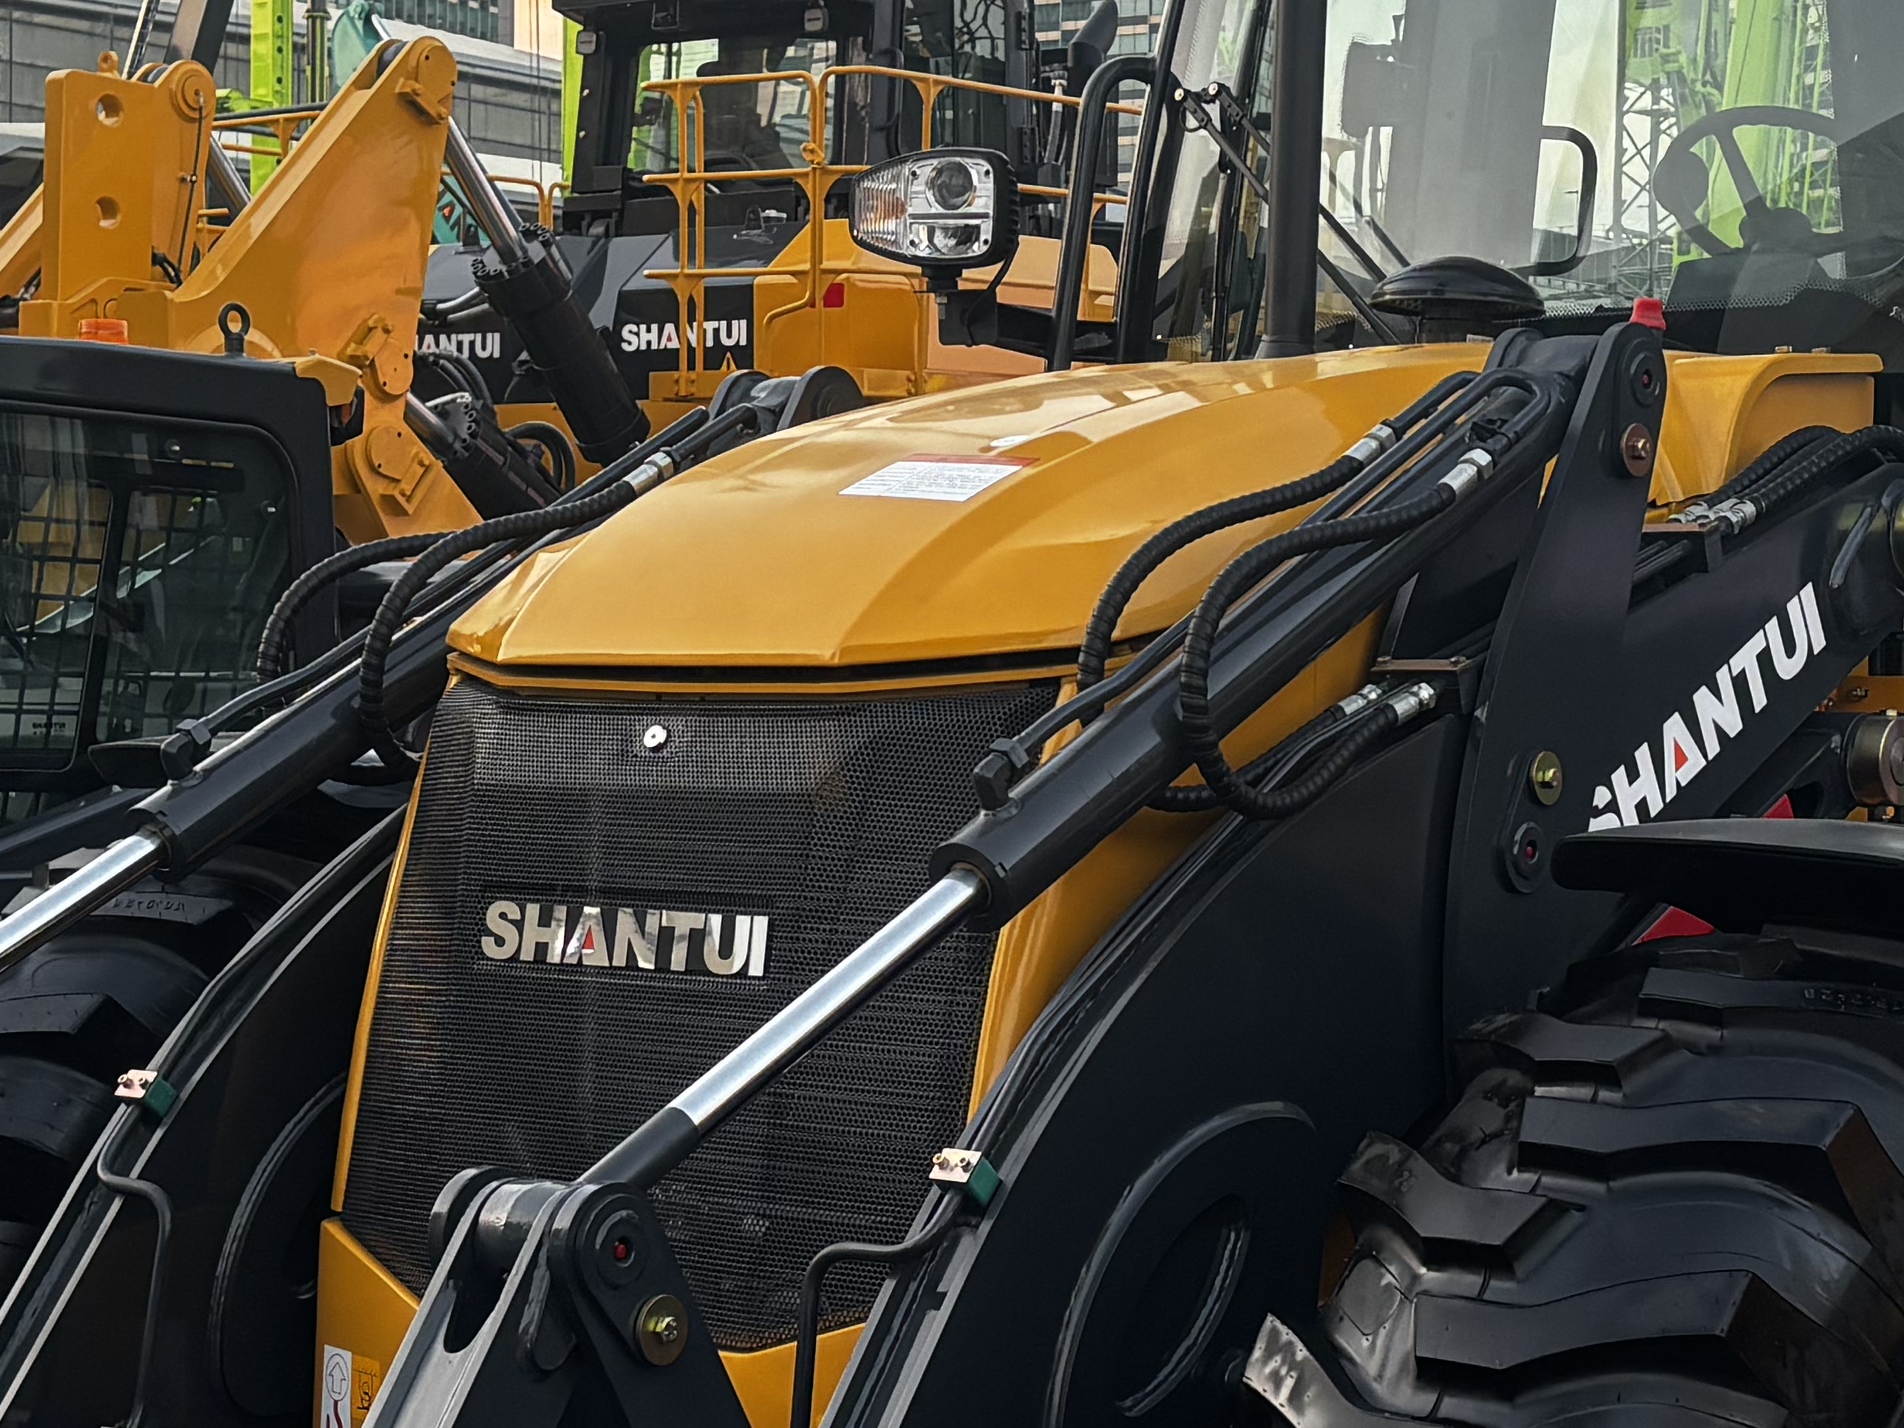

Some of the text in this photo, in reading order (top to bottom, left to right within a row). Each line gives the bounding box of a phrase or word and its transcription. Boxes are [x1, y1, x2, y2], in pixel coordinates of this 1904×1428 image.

[415, 332, 501, 360] ANTUI
[1587, 582, 1828, 832] SHANTUI
[480, 899, 769, 977] SHANTUI
